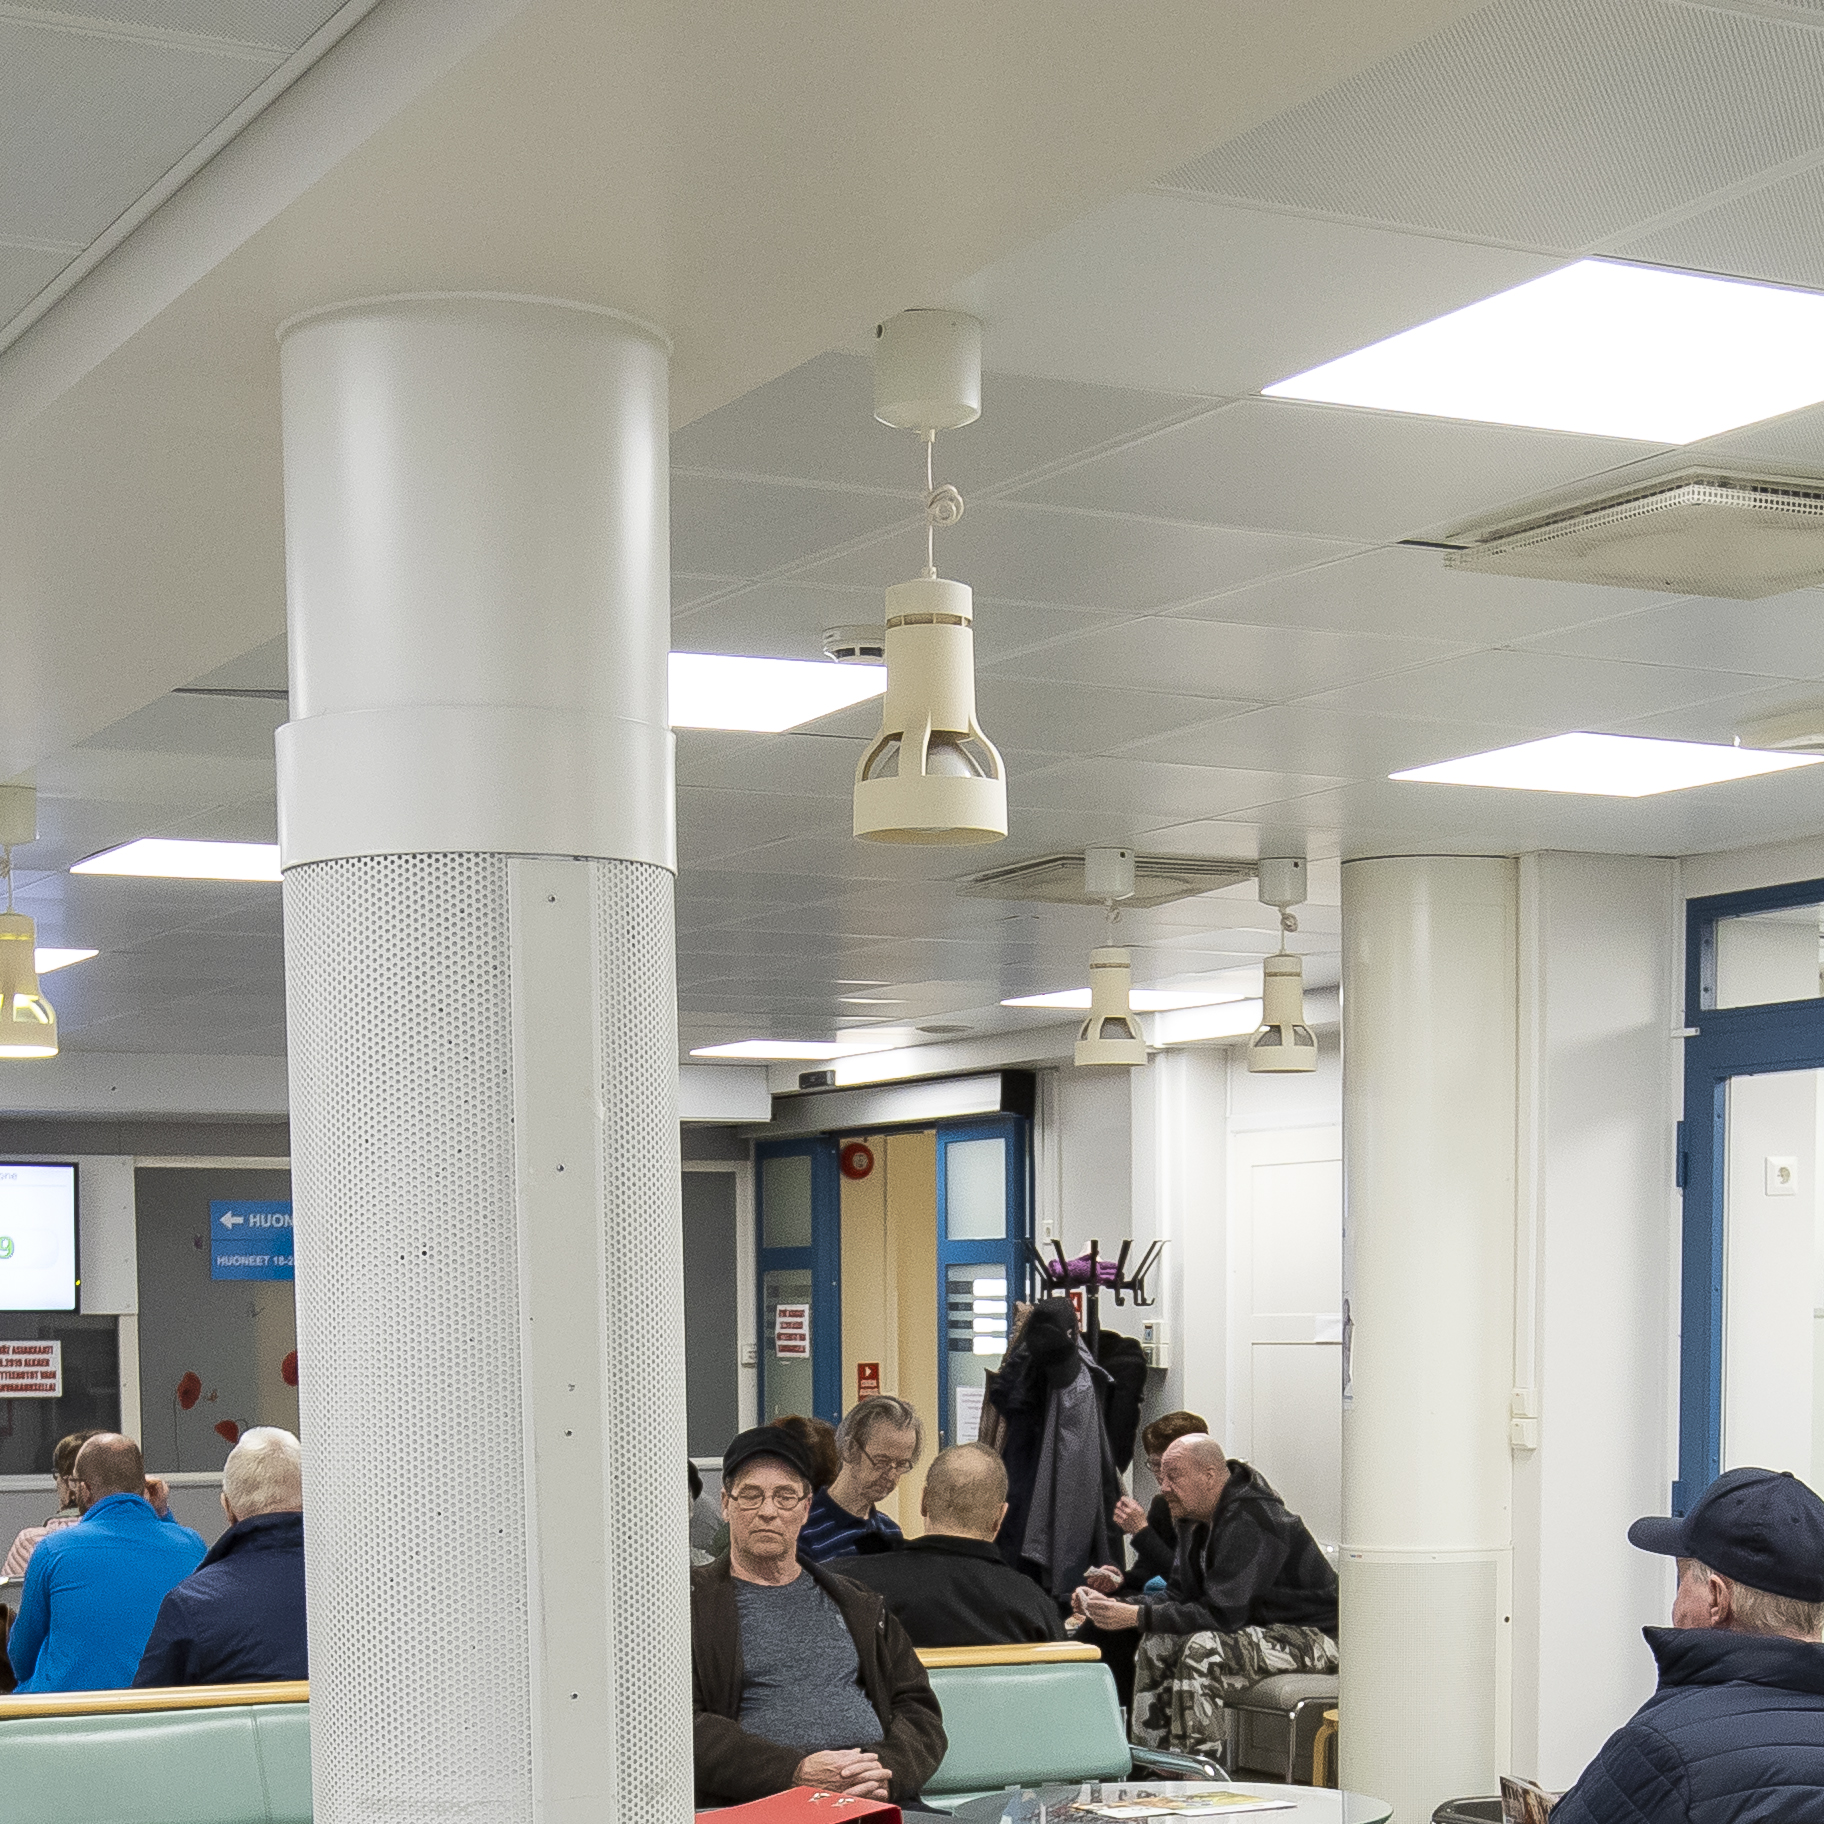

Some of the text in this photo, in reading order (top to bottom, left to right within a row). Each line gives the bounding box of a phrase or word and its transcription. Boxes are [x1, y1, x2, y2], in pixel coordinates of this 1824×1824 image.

[248, 1213, 294, 1228] HUON
[216, 1254, 294, 1267] HUONEET 18-2
